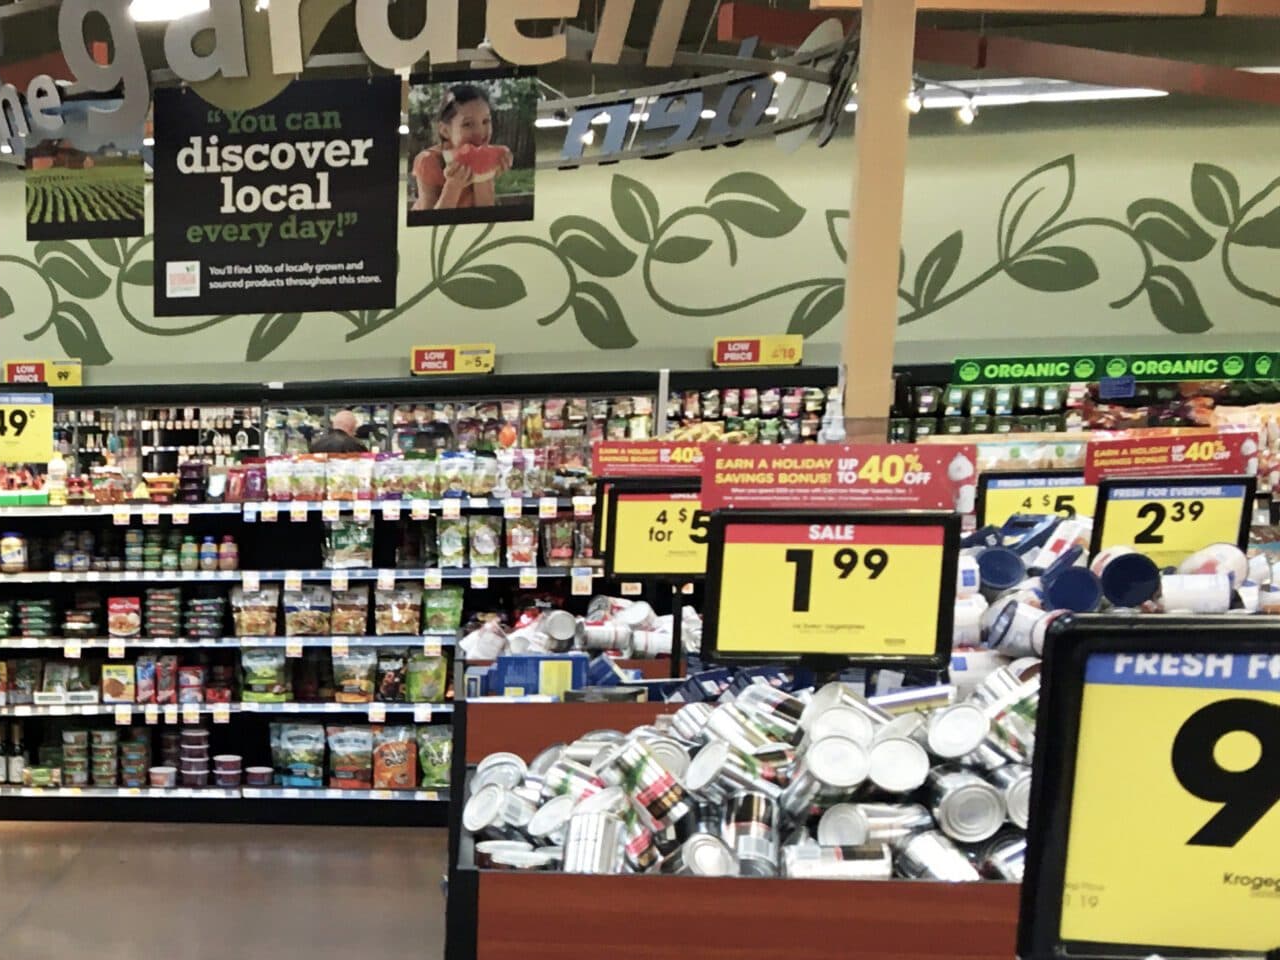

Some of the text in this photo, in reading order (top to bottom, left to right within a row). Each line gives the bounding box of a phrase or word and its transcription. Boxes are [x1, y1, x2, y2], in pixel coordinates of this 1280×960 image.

[285, 110, 342, 131] can
[176, 135, 374, 174] discover
[220, 172, 333, 214] local
[186, 222, 273, 248] every
[234, 265, 253, 274] find
[274, 263, 284, 273] of
[285, 262, 314, 274] locally
[315, 263, 345, 274] grown
[345, 260, 364, 271] and
[209, 279, 243, 289] sourced
[244, 278, 284, 290] products
[285, 276, 338, 288] throughout
[339, 275, 356, 284] this
[728, 343, 750, 352] LOW
[424, 352, 445, 360] LOW
[724, 352, 753, 361] PRICE
[16, 365, 36, 373] LOW
[421, 361, 448, 369] PRICE
[983, 363, 1070, 378] ORGANIC
[1131, 359, 1219, 375] ORGANIC
[14, 374, 38, 382] PRICE
[716, 458, 834, 469] EARN A HOLIDAY
[838, 458, 859, 469] UP
[715, 473, 832, 484] SAVINGS BONUS!
[837, 472, 932, 484] TO OFF
[1022, 497, 1032, 508] 4
[656, 510, 668, 524] 4
[1134, 501, 1205, 544] 2 39
[649, 526, 673, 542] for
[809, 525, 855, 540] SALE
[785, 548, 889, 612] 1 99
[1114, 653, 1233, 679] FRESH
[1171, 698, 1280, 848] 9
